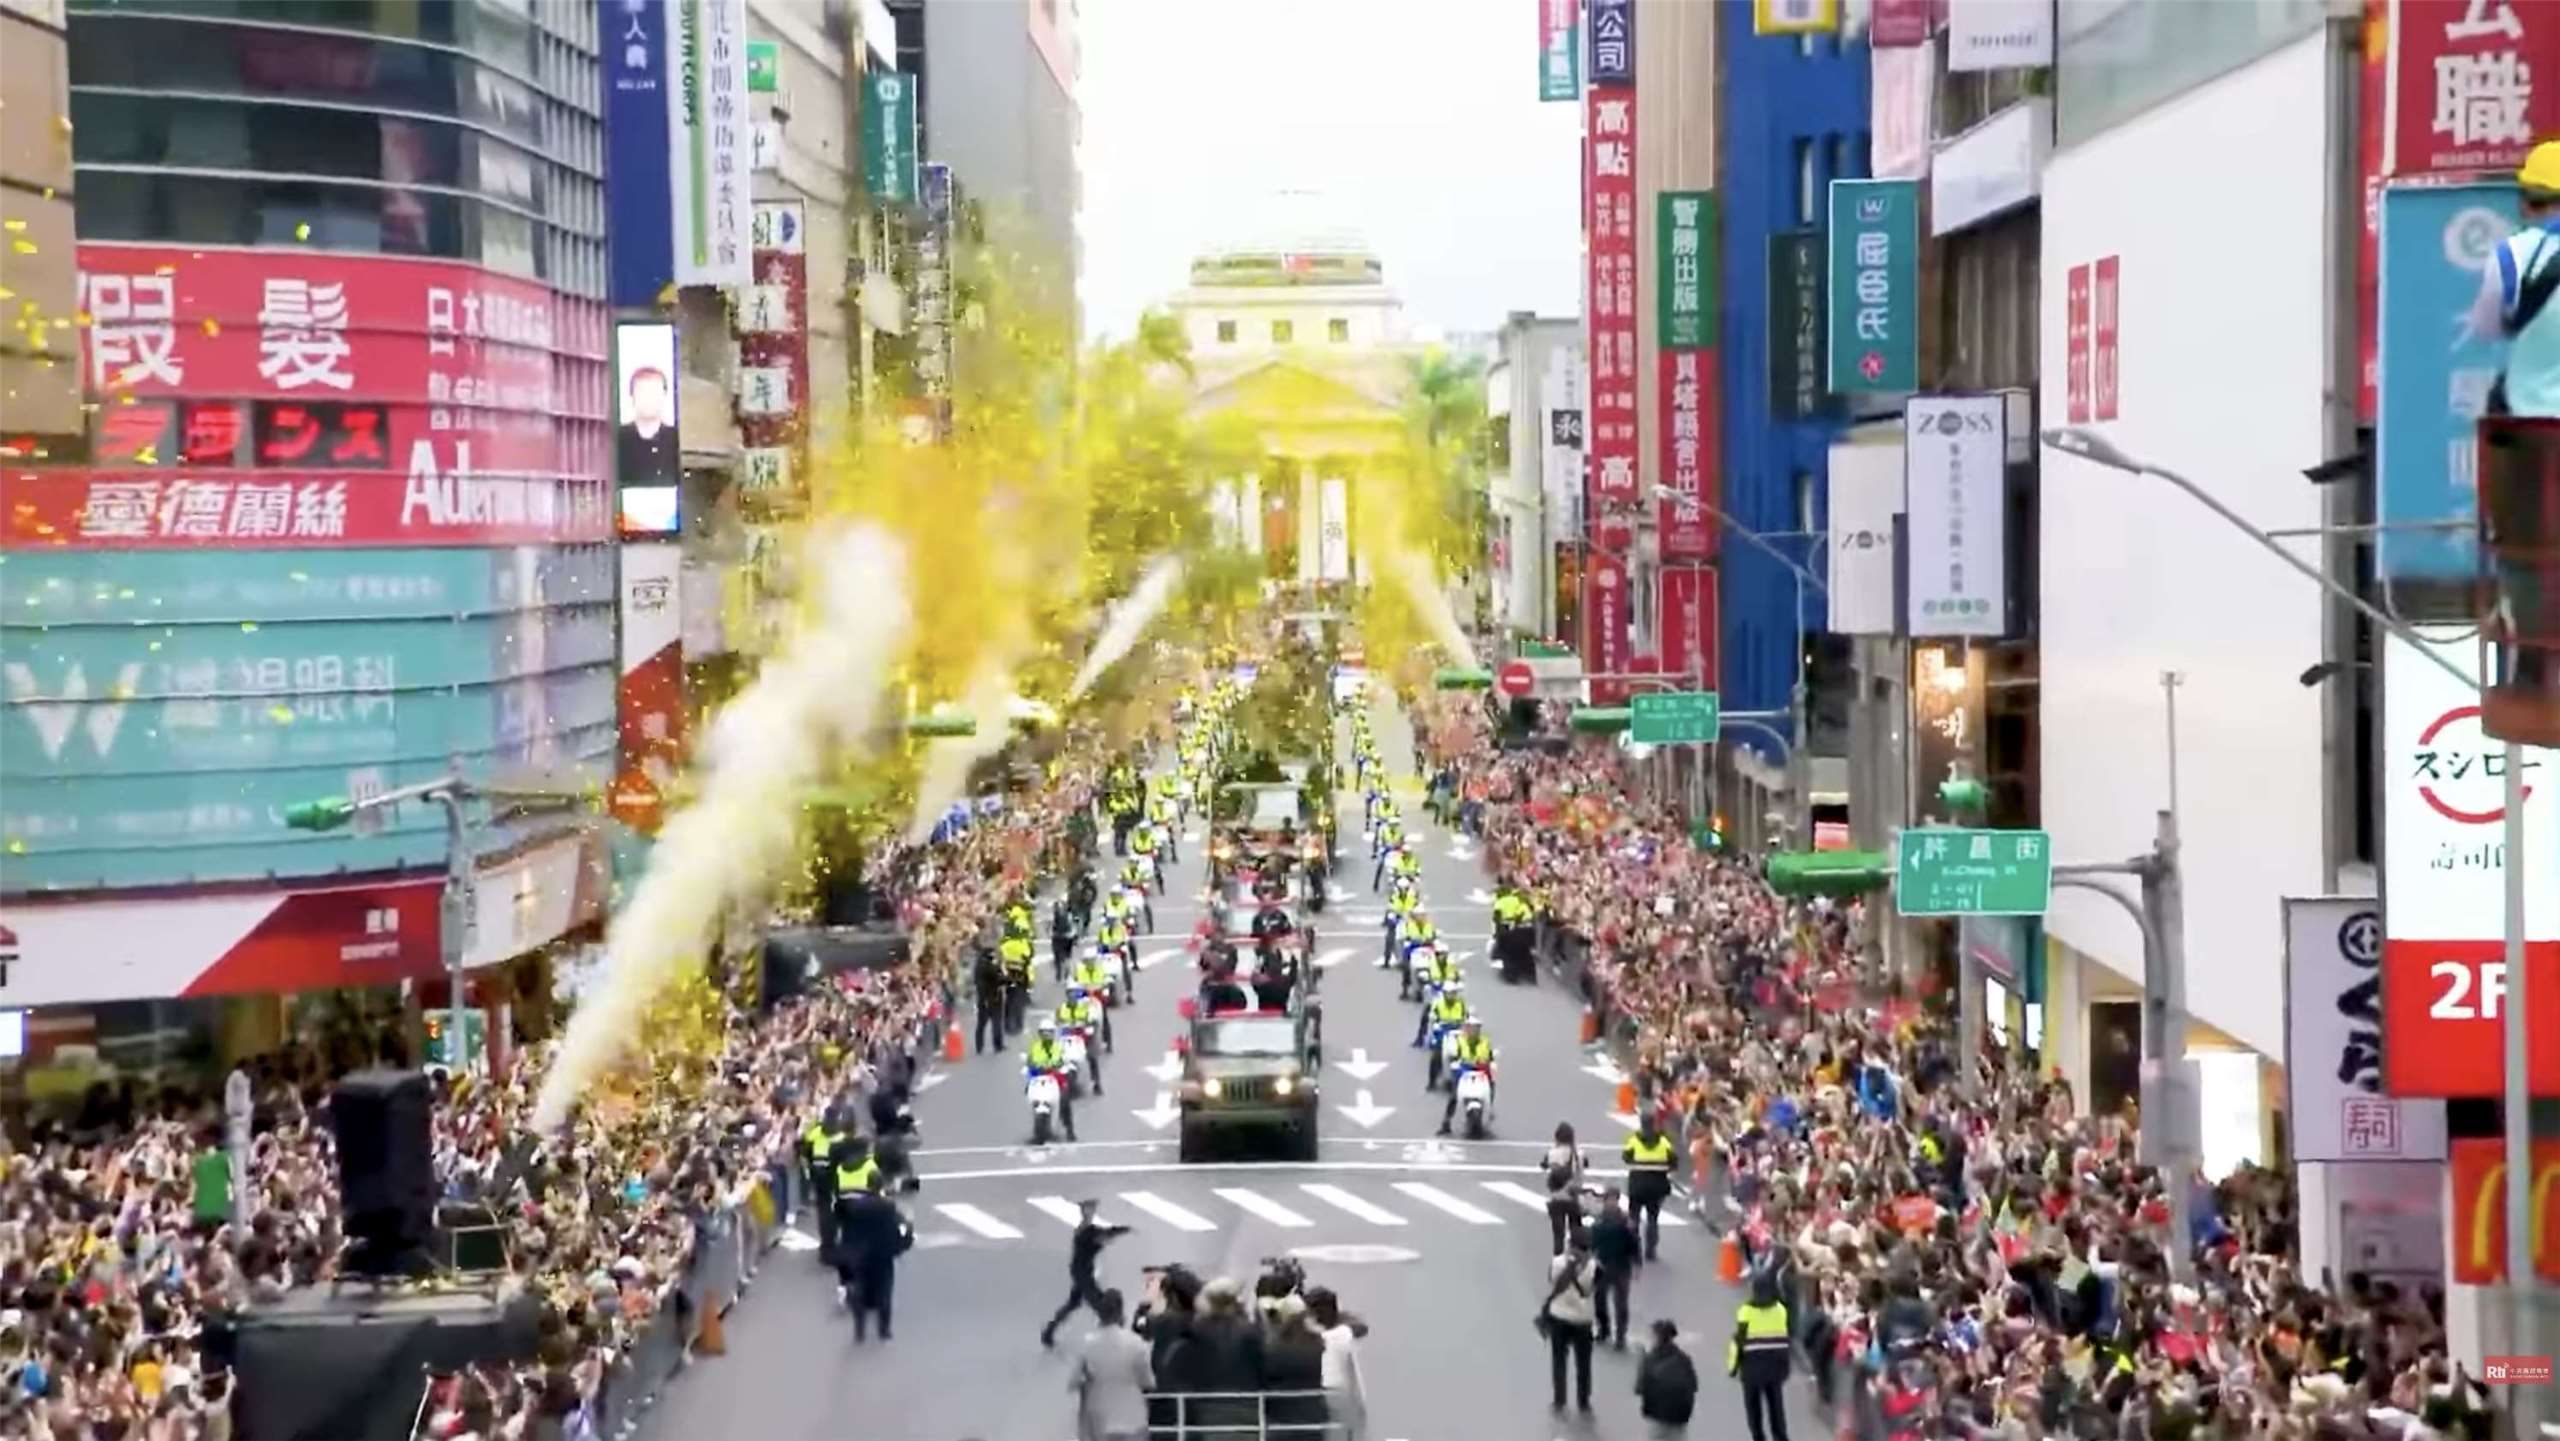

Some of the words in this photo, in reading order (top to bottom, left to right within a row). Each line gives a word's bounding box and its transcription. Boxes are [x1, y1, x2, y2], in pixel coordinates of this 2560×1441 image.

[1597, 0, 1625, 70] 公司
[79, 273, 354, 391] 假髮
[1841, 530, 1893, 549] ZOS
[2429, 961, 2507, 1019] 2F
